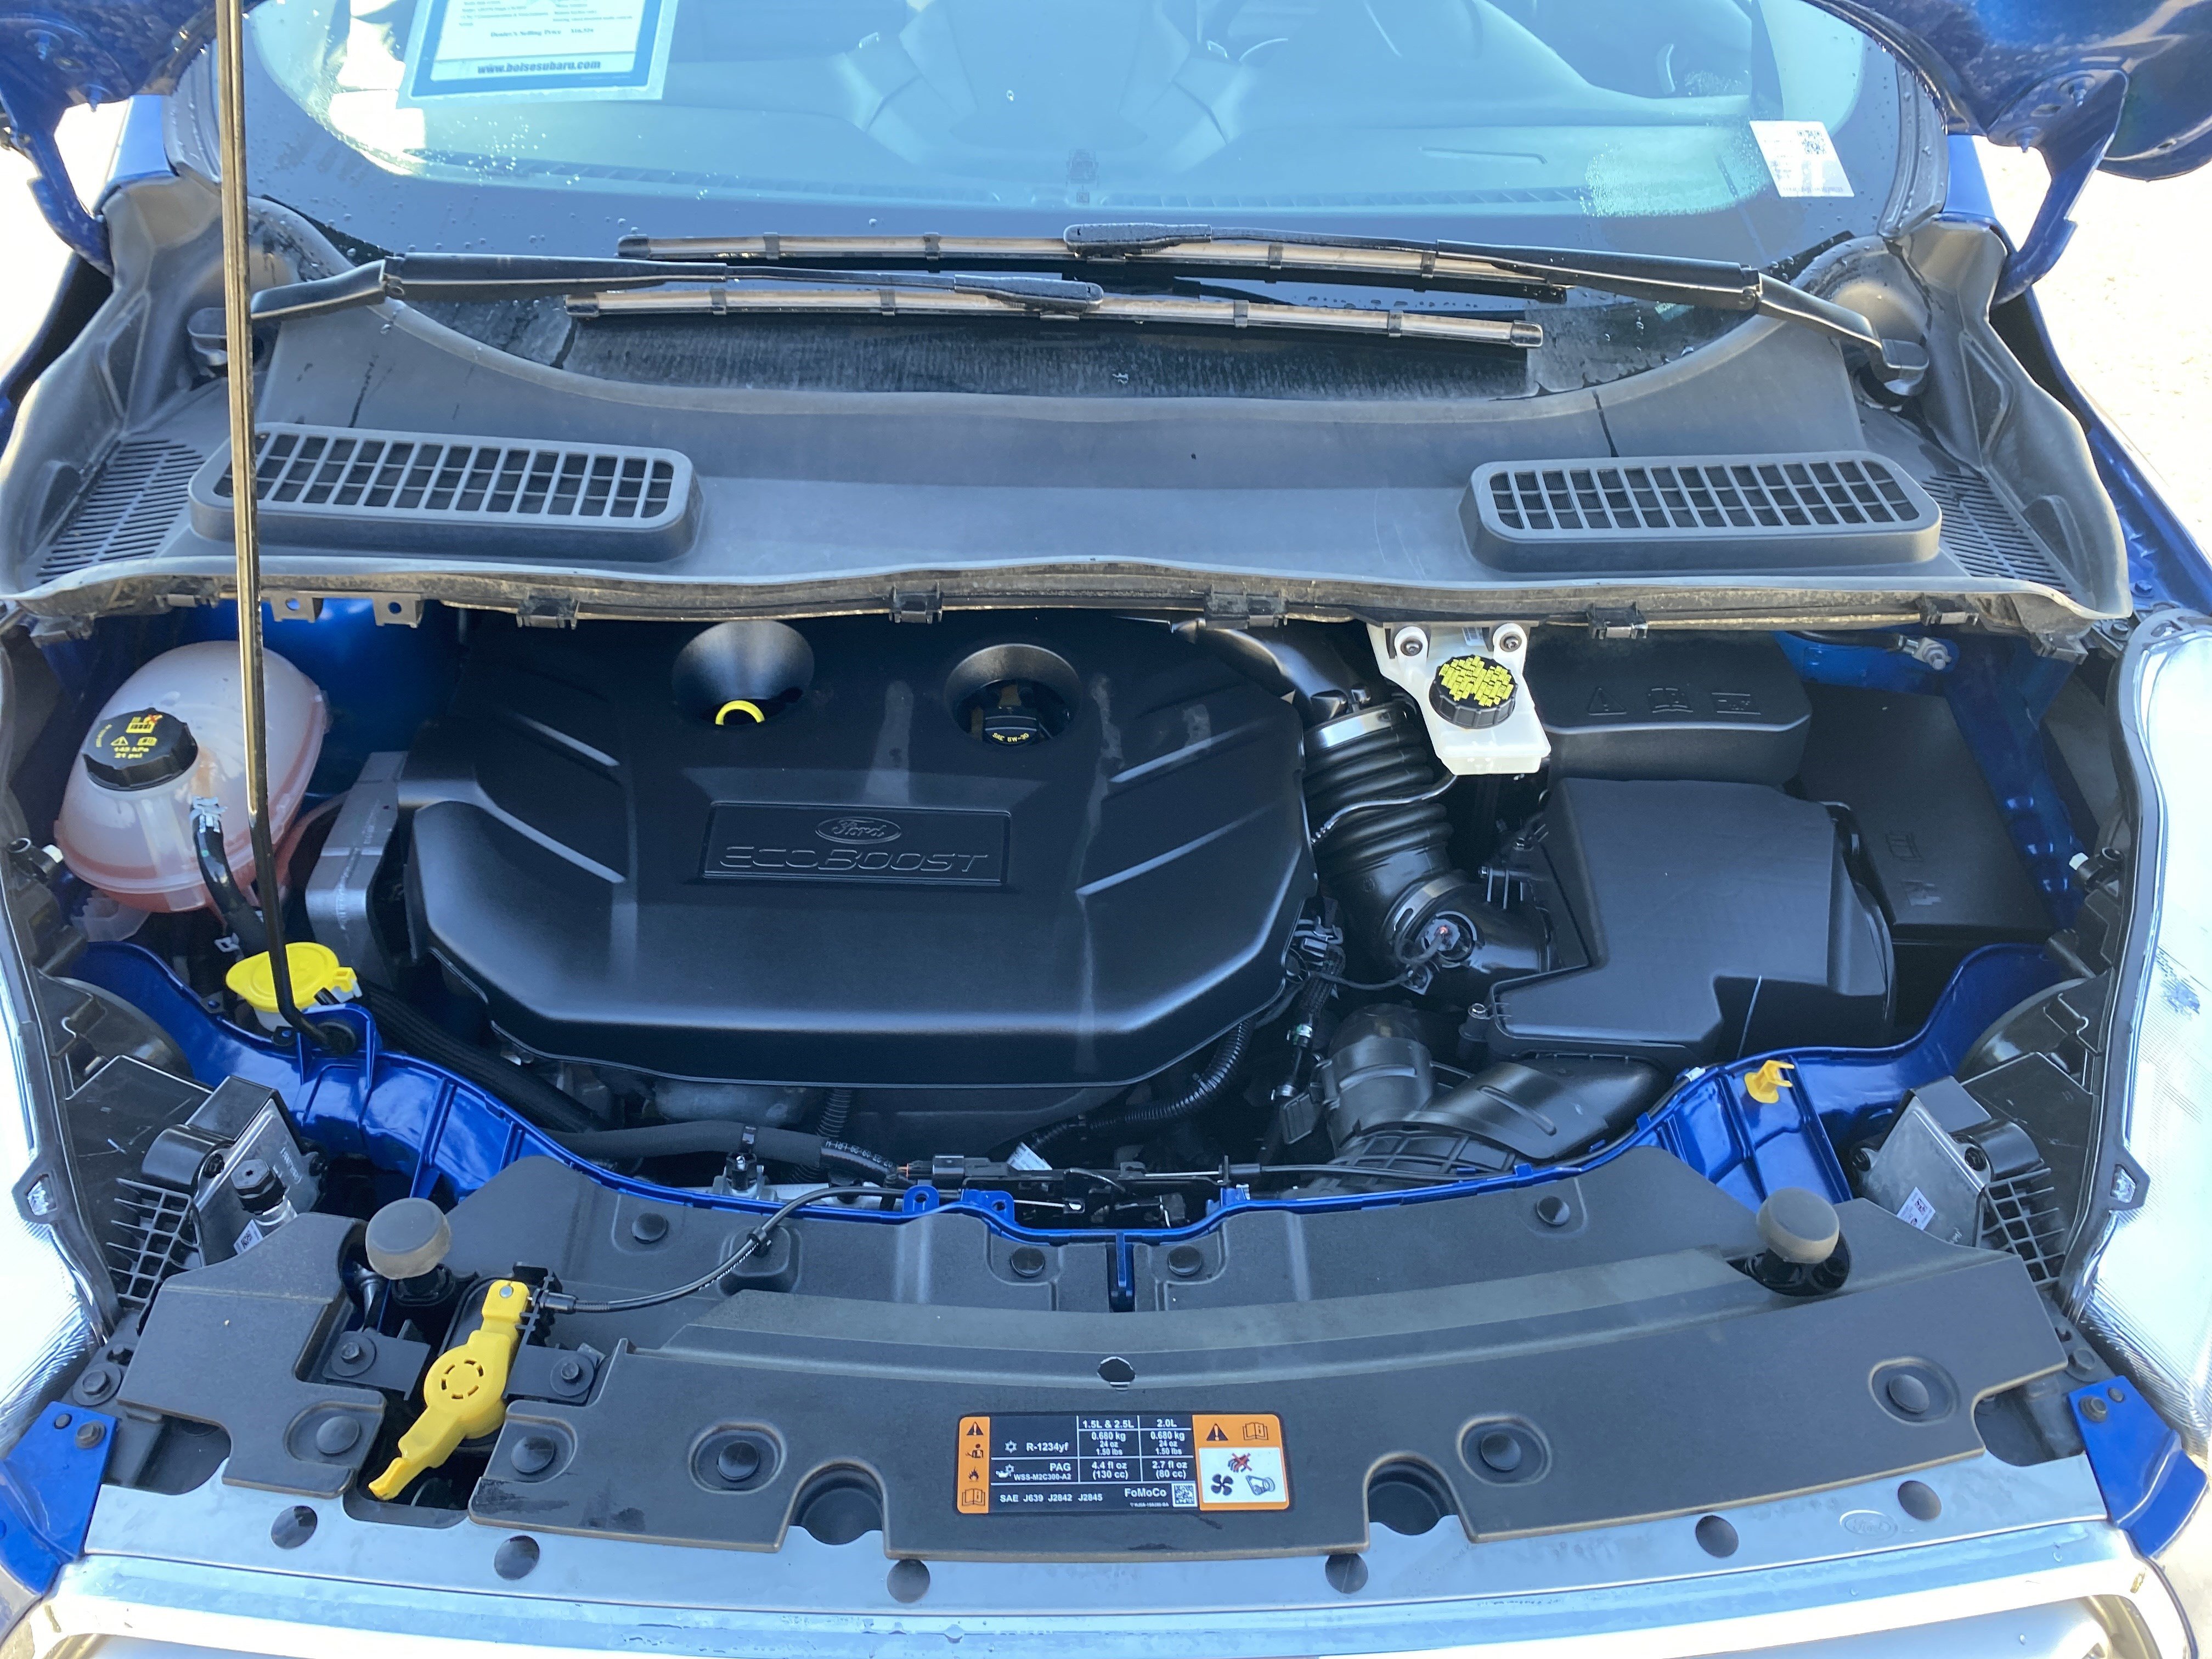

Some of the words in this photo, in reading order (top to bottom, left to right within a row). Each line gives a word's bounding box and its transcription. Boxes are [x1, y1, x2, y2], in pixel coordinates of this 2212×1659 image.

[832, 819, 887, 837] Ford
[719, 845, 988, 872] ECOBOOST
[1082, 1419, 1102, 1429] 1.5L
[1104, 1419, 1112, 1429] &
[1114, 1419, 1135, 1428] 2.5L
[1156, 1419, 1177, 1427] 2.0L
[1091, 1431, 1113, 1441] 0.680
[1115, 1431, 1126, 1442] kg
[1150, 1431, 1172, 1440] 0.680
[1173, 1431, 1185, 1441] kg
[1026, 1442, 1069, 1453] R-1234yf
[1049, 1463, 1071, 1472] PAG
[1091, 1461, 1105, 1469] 4.4
[1107, 1460, 1114, 1469] fl
[1152, 1460, 1166, 1469] 2.7
[1167, 1460, 1174, 1469] fl
[1013, 1473, 1071, 1481] WSS-M2C300-A2
[1092, 1470, 1112, 1481] (130
[1114, 1470, 1128, 1480] cc)
[1155, 1469, 1170, 1480] (80
[1172, 1469, 1187, 1480] cc)
[1124, 1487, 1167, 1498] FoMoCo
[1000, 1494, 1019, 1503] SAE
[1023, 1494, 1044, 1503] J639
[1047, 1493, 1073, 1502] J2842
[1077, 1493, 1103, 1502] J2845
